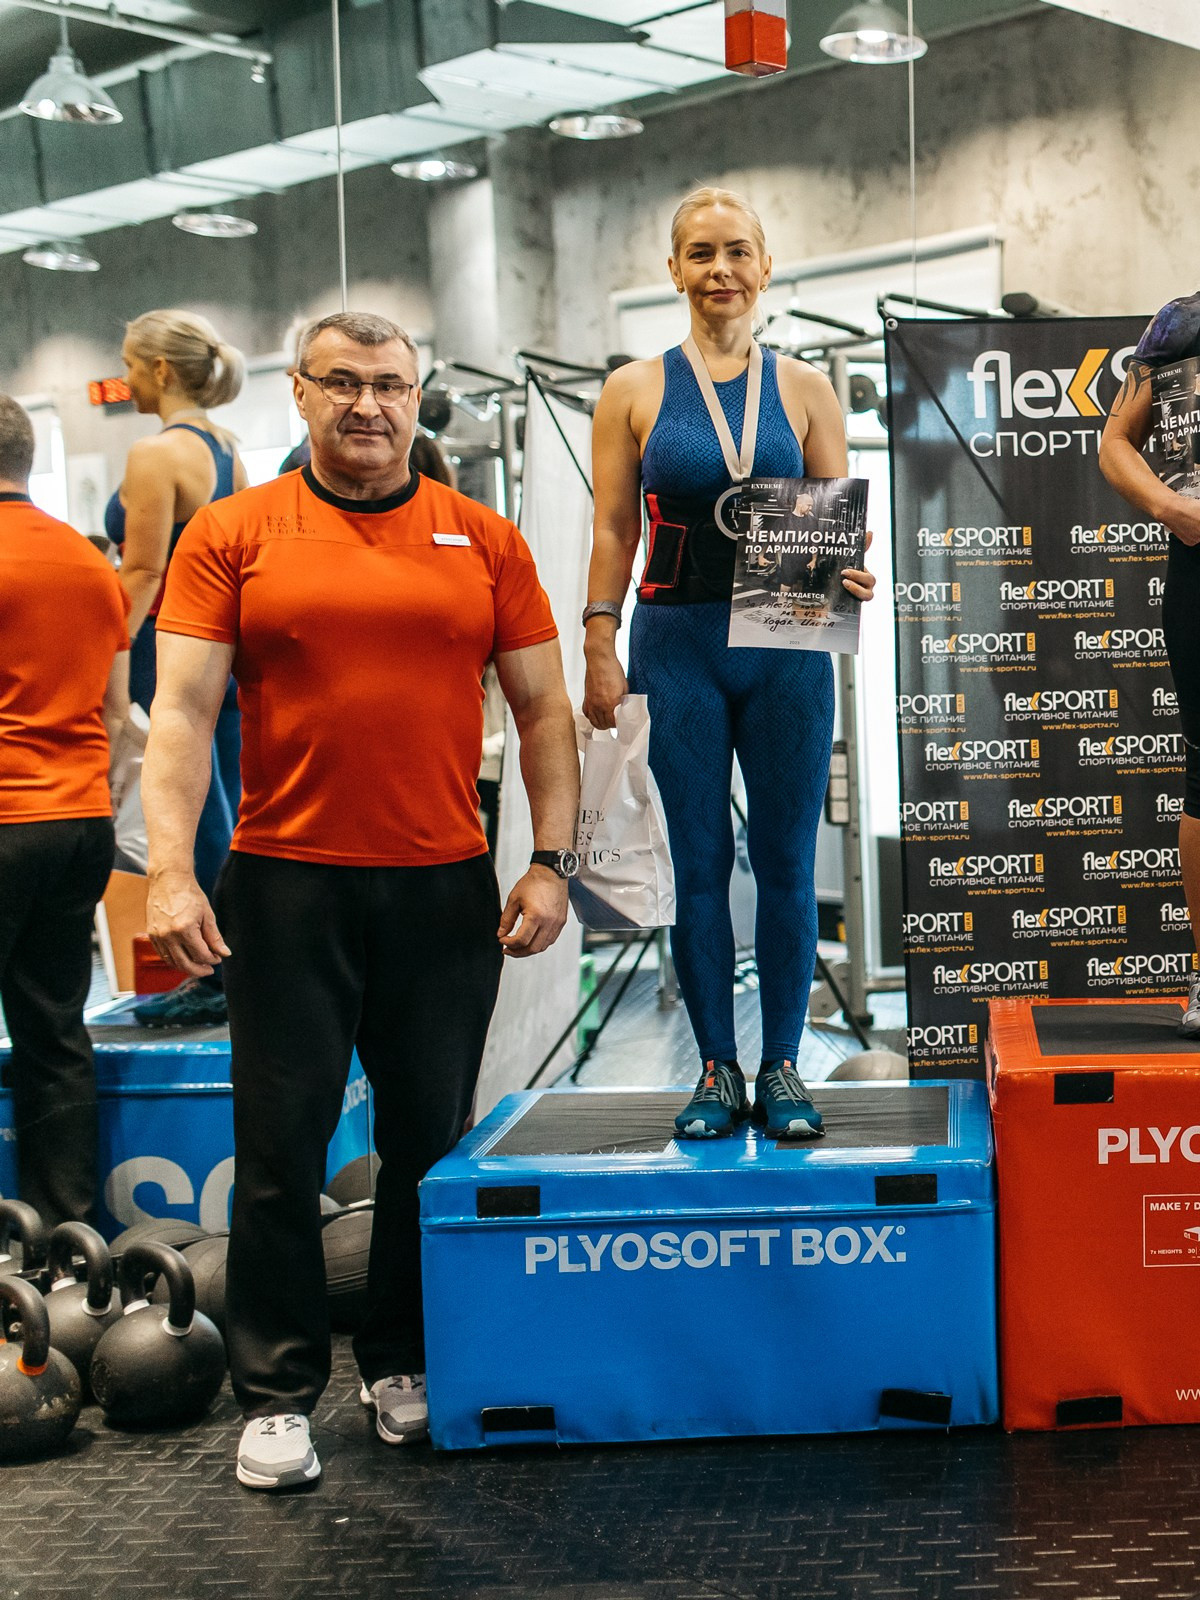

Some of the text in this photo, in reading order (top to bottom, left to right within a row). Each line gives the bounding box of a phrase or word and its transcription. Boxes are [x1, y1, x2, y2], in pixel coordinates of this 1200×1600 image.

[1157, 368, 1182, 380] EXTREME
[1162, 432, 1174, 443] ПО
[970, 430, 1102, 458] СПОРТ
[746, 530, 858, 545] ЧЕМПИОНАТ
[745, 545, 857, 557] ПО АРМЛИФТИНГУ
[917, 548, 1032, 557] СПОРТИВНОЕ ПИТАНИЕ
[1000, 600, 1114, 610] СПОРТИВНОЕ ПИТАНИЕ
[921, 653, 1036, 663] СПОРТИВНОЕ ПИТАНИЕ
[1004, 710, 1118, 721] СПОРТИВНОЕ ПИТАНИЕ
[925, 760, 1040, 771] СПОРТИВНОЕ ПИТАНИЕ
[1008, 817, 1122, 828] СПОРТИВНОЕ ПИТАНИЕ
[929, 875, 1044, 887] СПОРТИВНОЕ ПИТАНИЕ
[1012, 926, 1126, 938] СПОРТИВНОЕ ПИТАНИЕ
[933, 981, 1049, 994] СПОРТИВНОЕ ПИТАНИЕ
[1150, 1202, 1181, 1211] MAKE
[1185, 1201, 1190, 1210] 7
[525, 1229, 780, 1275] PLYOSOFT
